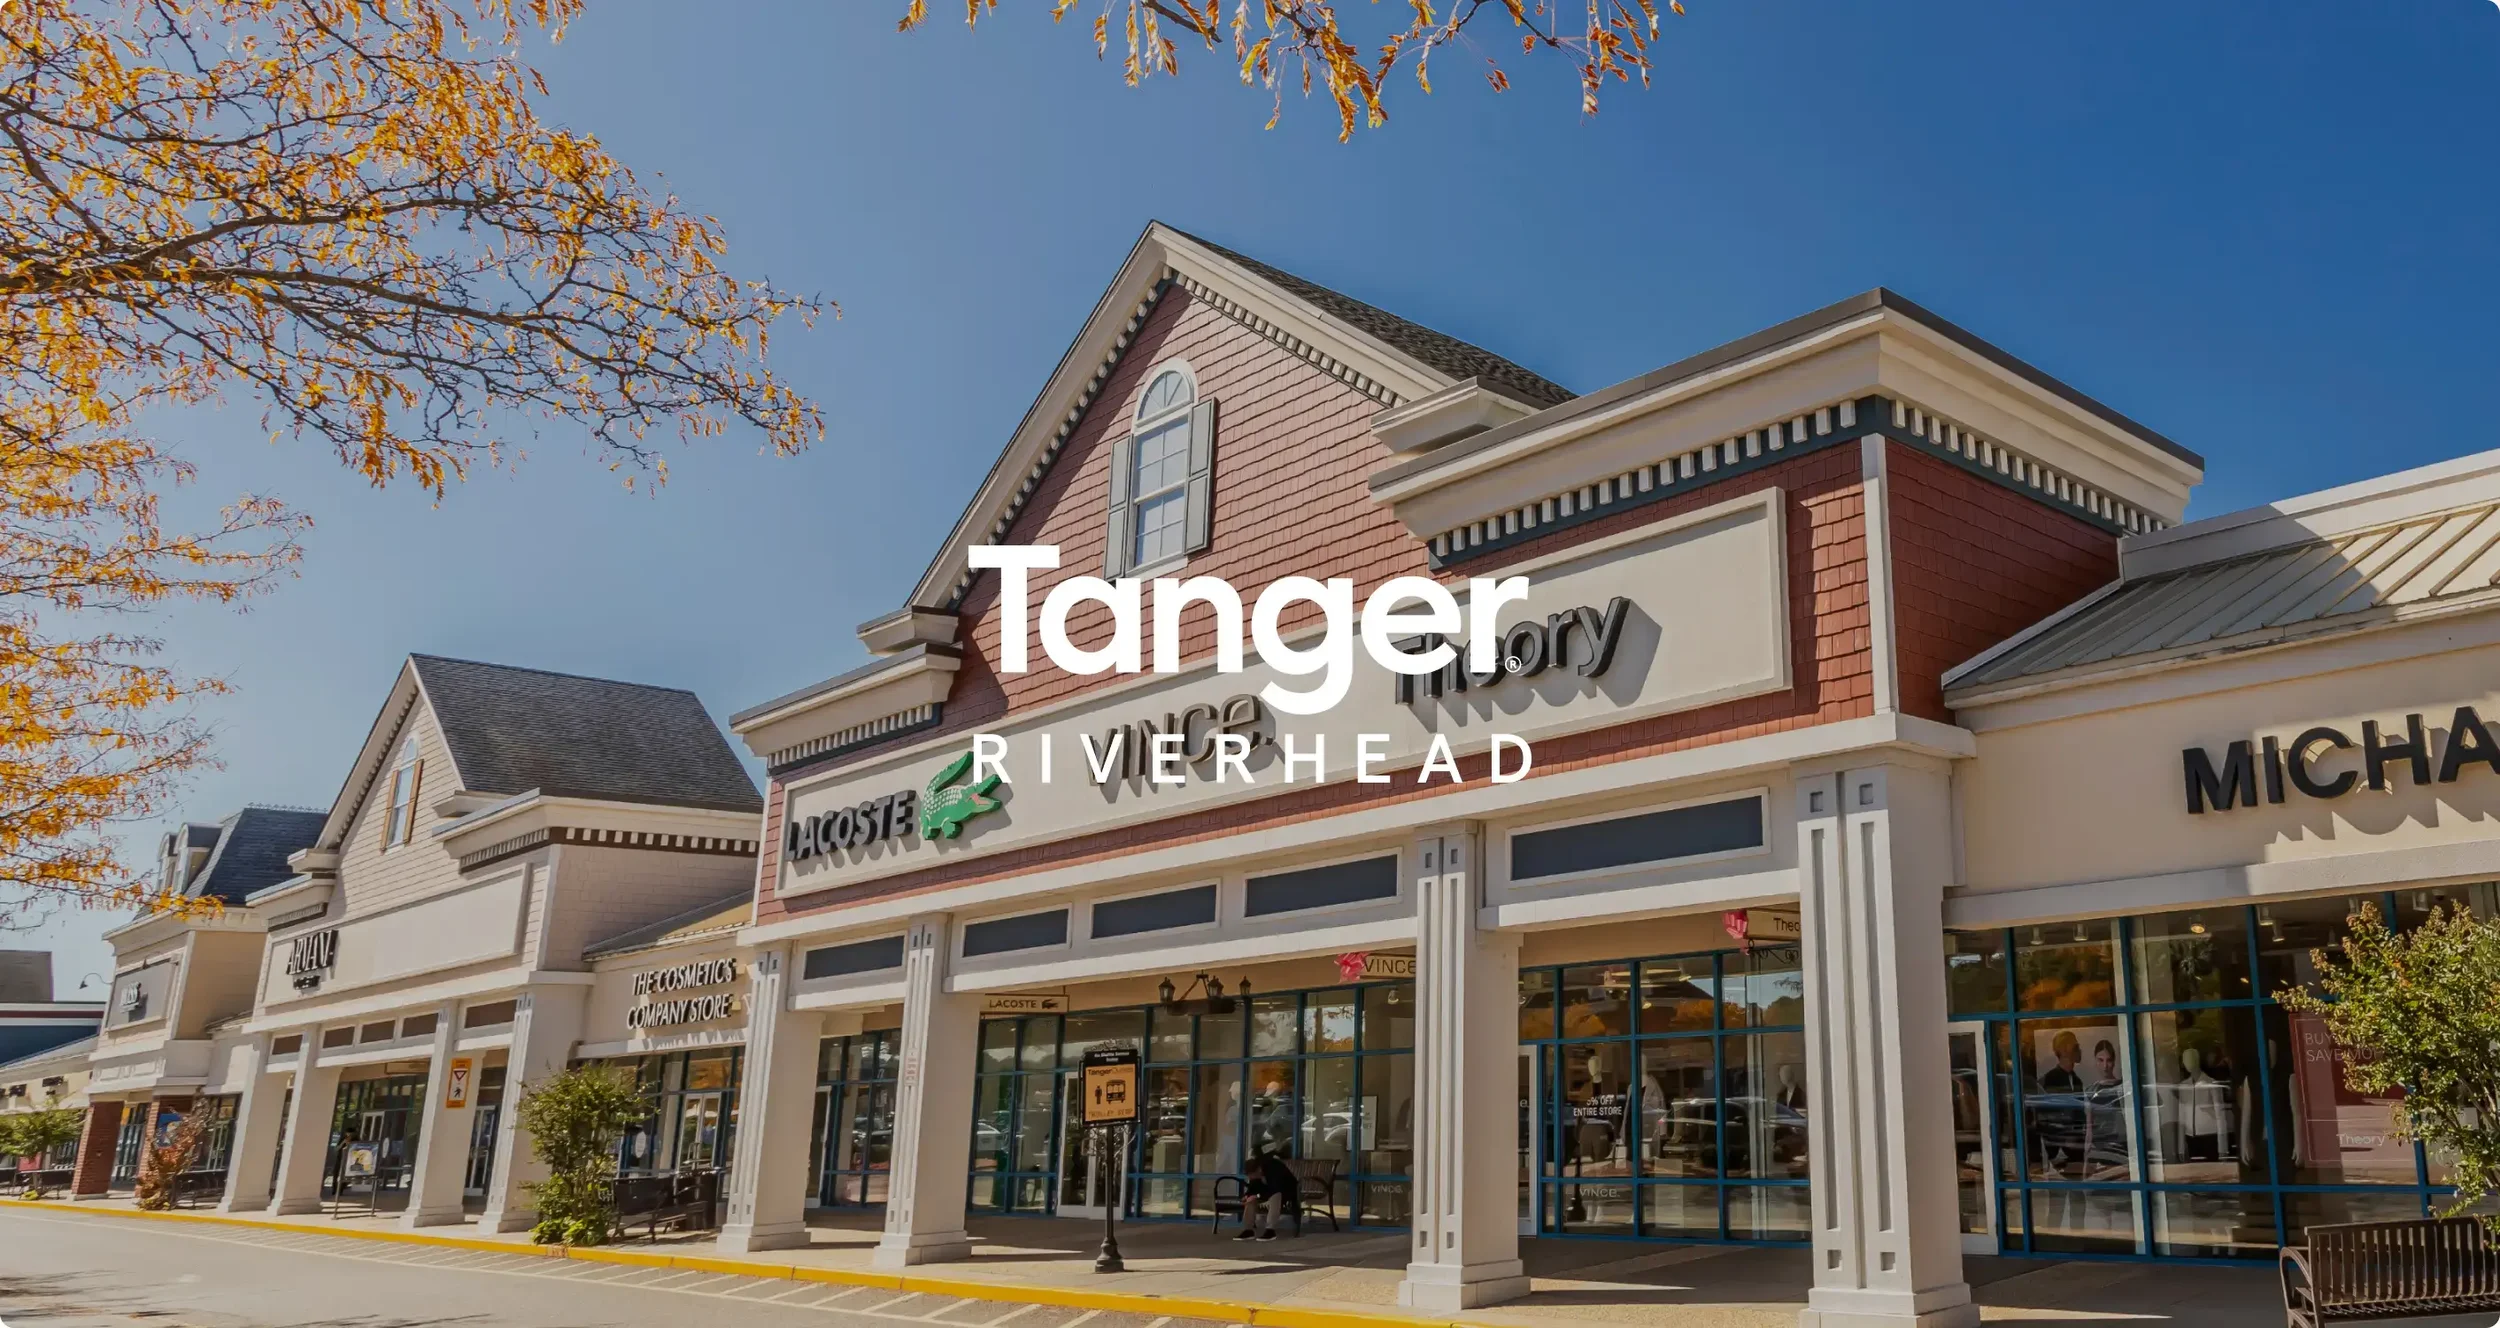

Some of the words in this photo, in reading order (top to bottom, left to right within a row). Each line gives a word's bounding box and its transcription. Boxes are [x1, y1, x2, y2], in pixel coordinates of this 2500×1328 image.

[2182, 706, 2500, 814] MICHA
[785, 789, 916, 861] LACOSTE
[632, 971, 658, 996] THE
[657, 958, 737, 992] COSMETICS
[989, 999, 1037, 1009] LACOSTE
[626, 1000, 688, 1030] COMPANY
[689, 994, 734, 1021] STORE
[2305, 1032, 2334, 1045] BUY
[2306, 1048, 2343, 1062] SAVE
[1573, 1107, 1598, 1117] ENTIRE
[1599, 1106, 1623, 1116] STORE
[2336, 1132, 2386, 1147] Theory
